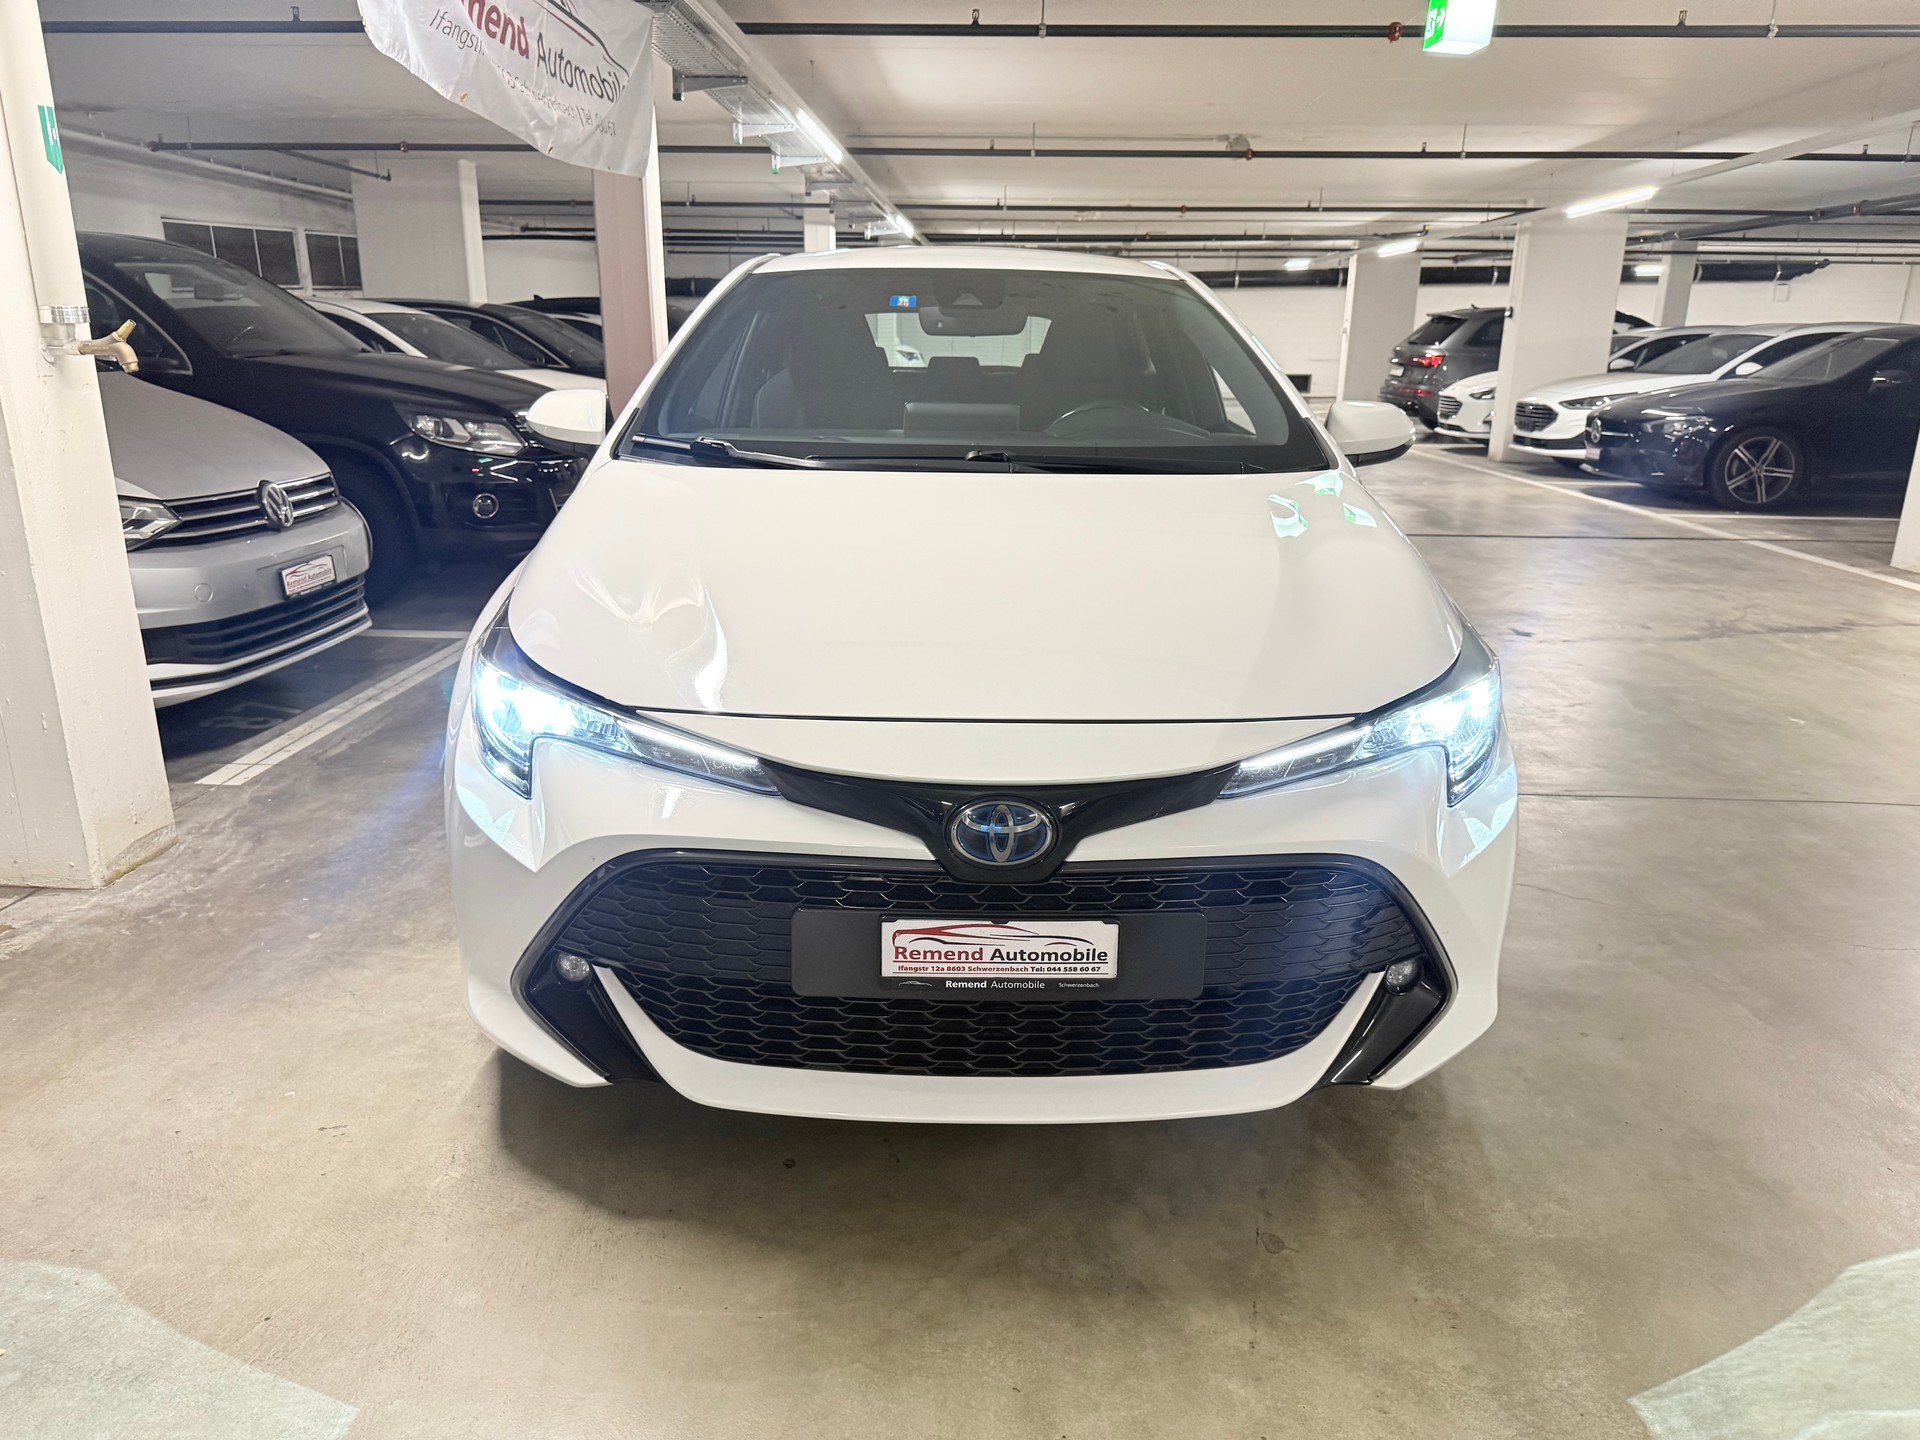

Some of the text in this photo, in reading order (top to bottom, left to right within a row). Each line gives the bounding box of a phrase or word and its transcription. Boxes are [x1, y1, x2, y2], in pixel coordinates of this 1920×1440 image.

[537, 32, 624, 104] Automobil
[894, 946, 1108, 961] Remend Automobile
[898, 965, 929, 973] Ifangstr
[945, 980, 987, 989] Remend
[990, 980, 1045, 989] Automobile
